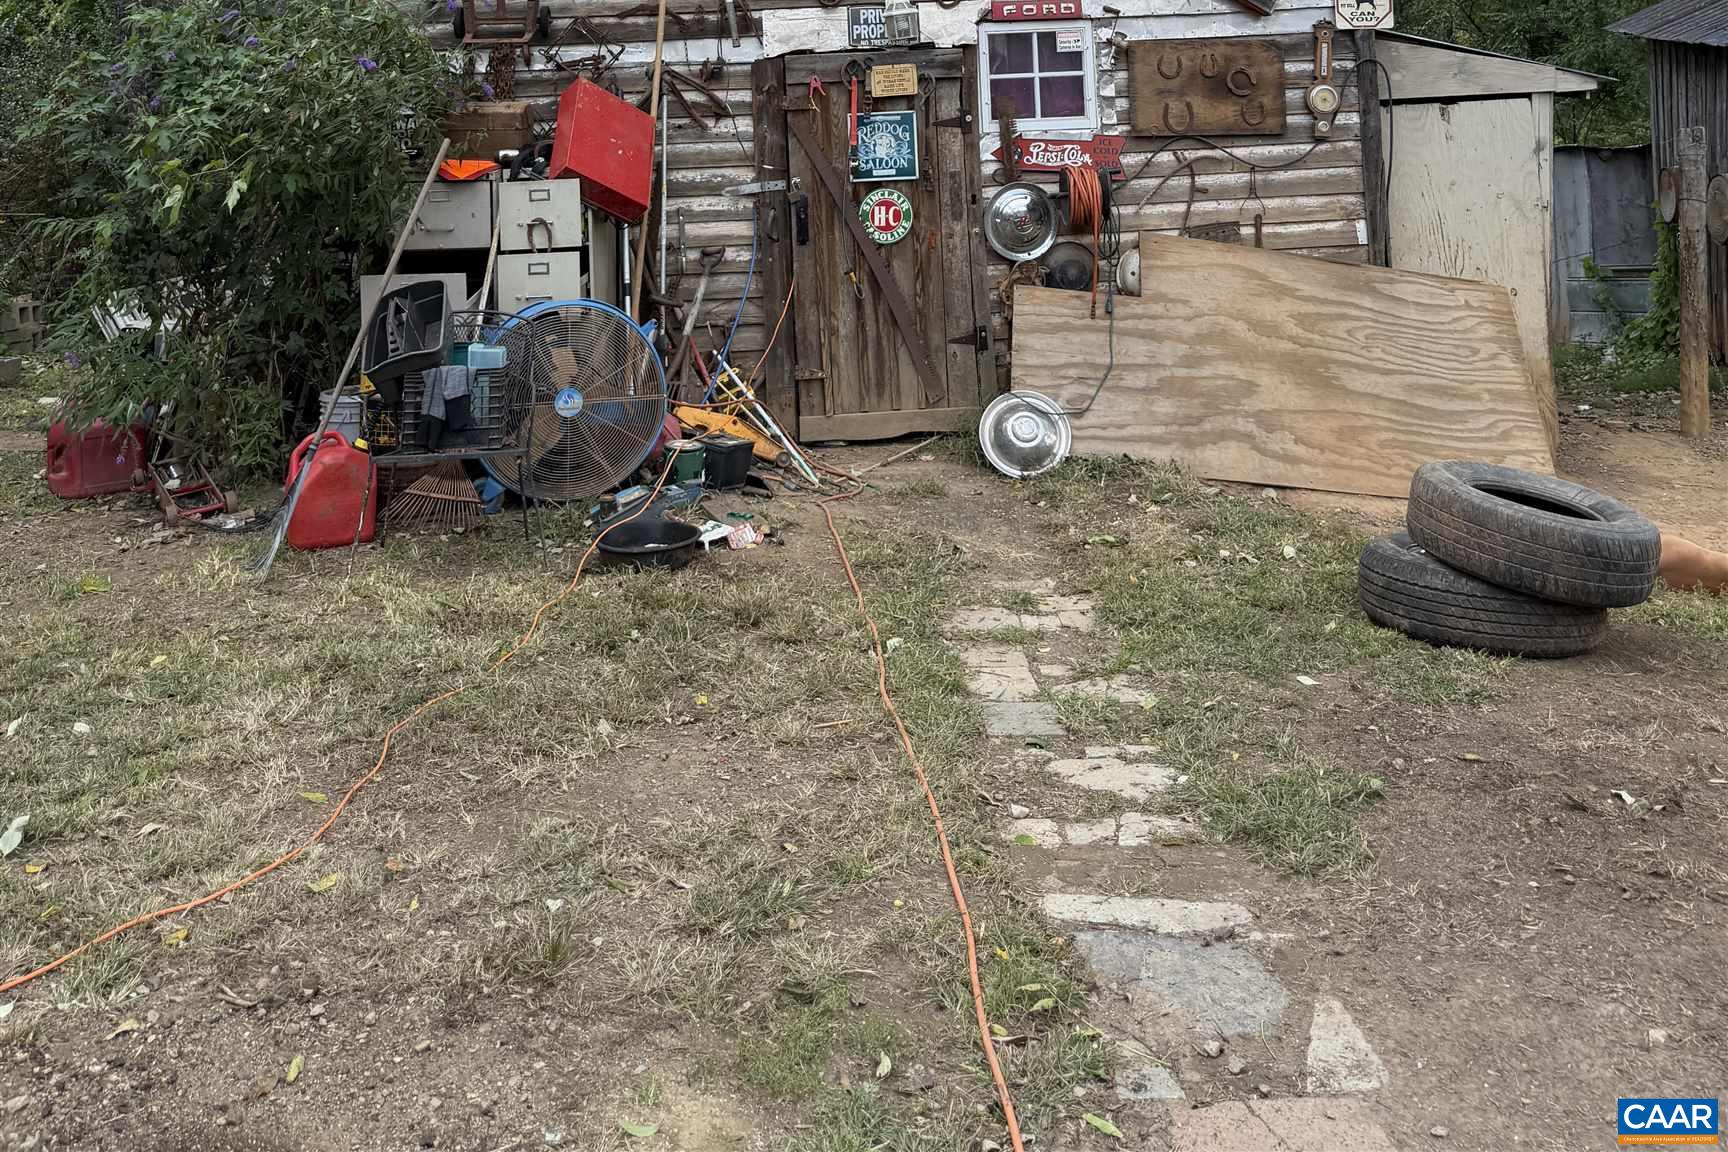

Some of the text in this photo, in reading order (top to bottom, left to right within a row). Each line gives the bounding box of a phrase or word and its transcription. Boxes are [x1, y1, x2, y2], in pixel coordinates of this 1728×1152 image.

[1002, 3, 1075, 16] FORD
[859, 157, 908, 171] SALOON
[863, 191, 909, 211] SINCLAIR
[863, 220, 910, 241] GASOLINE
